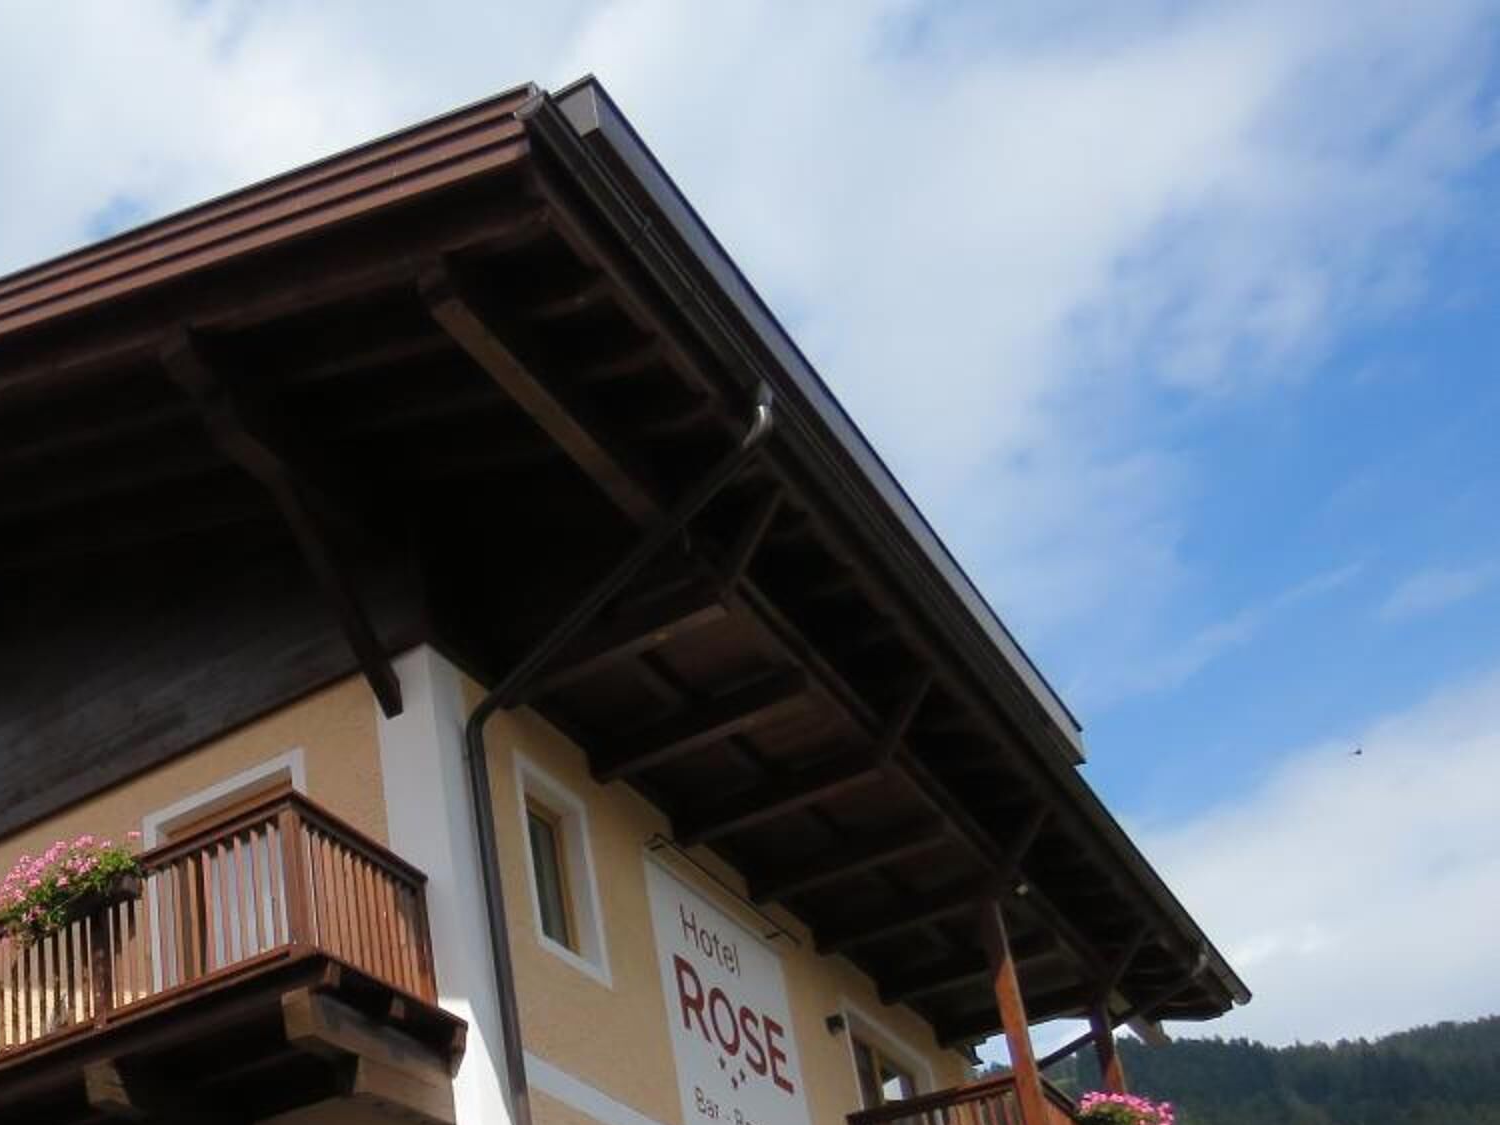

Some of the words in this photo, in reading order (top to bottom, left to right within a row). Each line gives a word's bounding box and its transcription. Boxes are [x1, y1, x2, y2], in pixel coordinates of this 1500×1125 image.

[678, 902, 742, 978] Hotel
[672, 952, 796, 1097] ROSE
[694, 1086, 721, 1121] Bar
